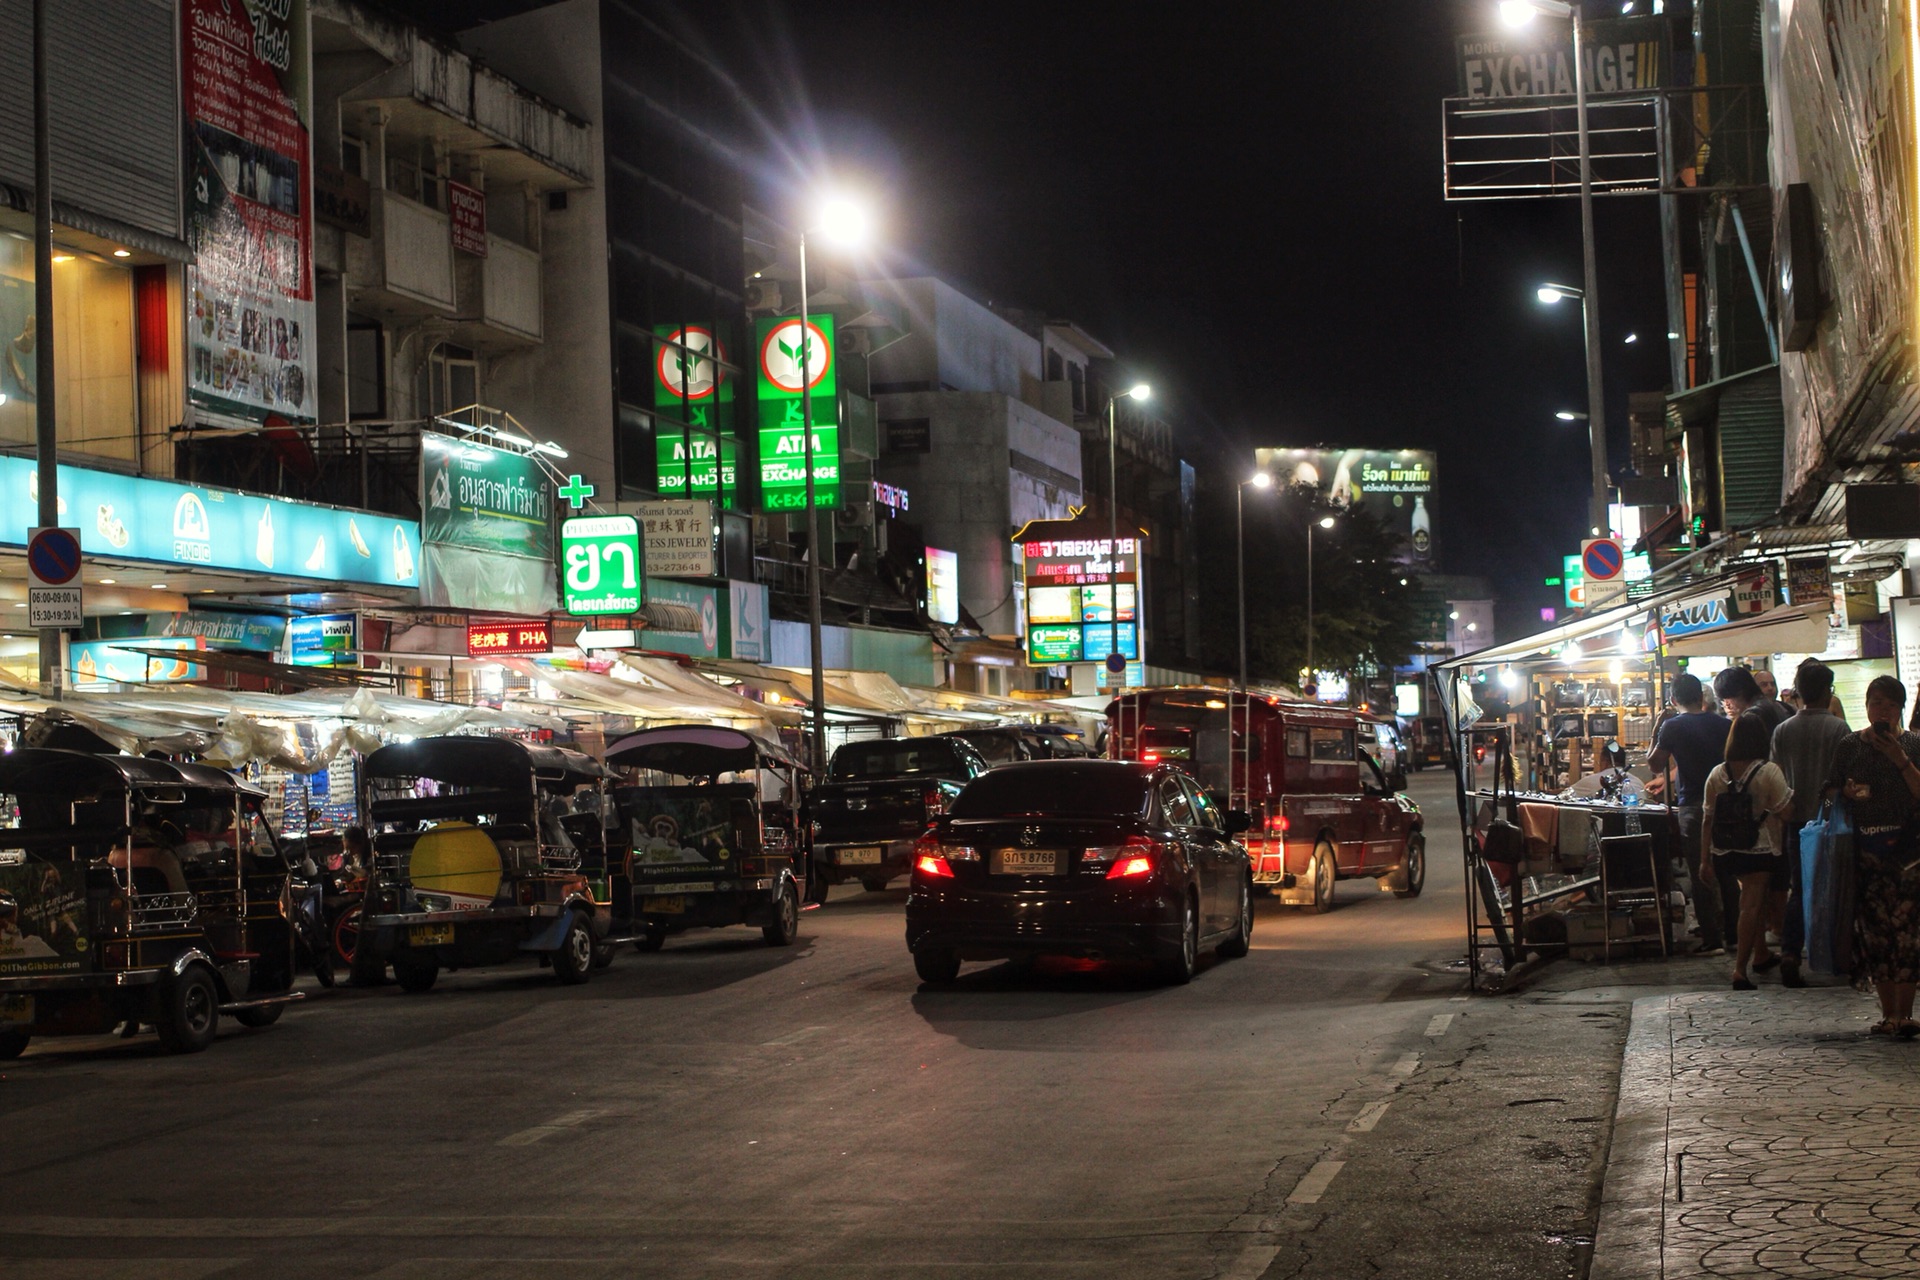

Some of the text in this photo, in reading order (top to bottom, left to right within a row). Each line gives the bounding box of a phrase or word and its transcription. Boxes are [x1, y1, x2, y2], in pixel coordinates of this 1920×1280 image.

[250, 10, 290, 71] Hostel
[1464, 42, 1507, 56] MONEY
[1465, 43, 1635, 99] EXCHANGE
[775, 434, 822, 454] ATM
[762, 466, 837, 482] EXCHANGE
[460, 476, 548, 520] อนุสารฟาร์มาซี
[566, 521, 631, 534] PHARMACY
[667, 537, 708, 548] JEWELRY
[173, 540, 211, 562] FINDIG
[678, 551, 708, 560] EXPORTER
[566, 542, 637, 591] ยา
[1037, 564, 1081, 575] Anusarn
[32, 593, 71, 603] 06:00-09:00
[567, 593, 637, 612] โดยเภสัชกร
[32, 610, 72, 622] 15:30-19:30
[470, 631, 547, 648] 老虎膏 PHA
[1029, 852, 1054, 863] 8766
[23, 903, 43, 917] ONLY
